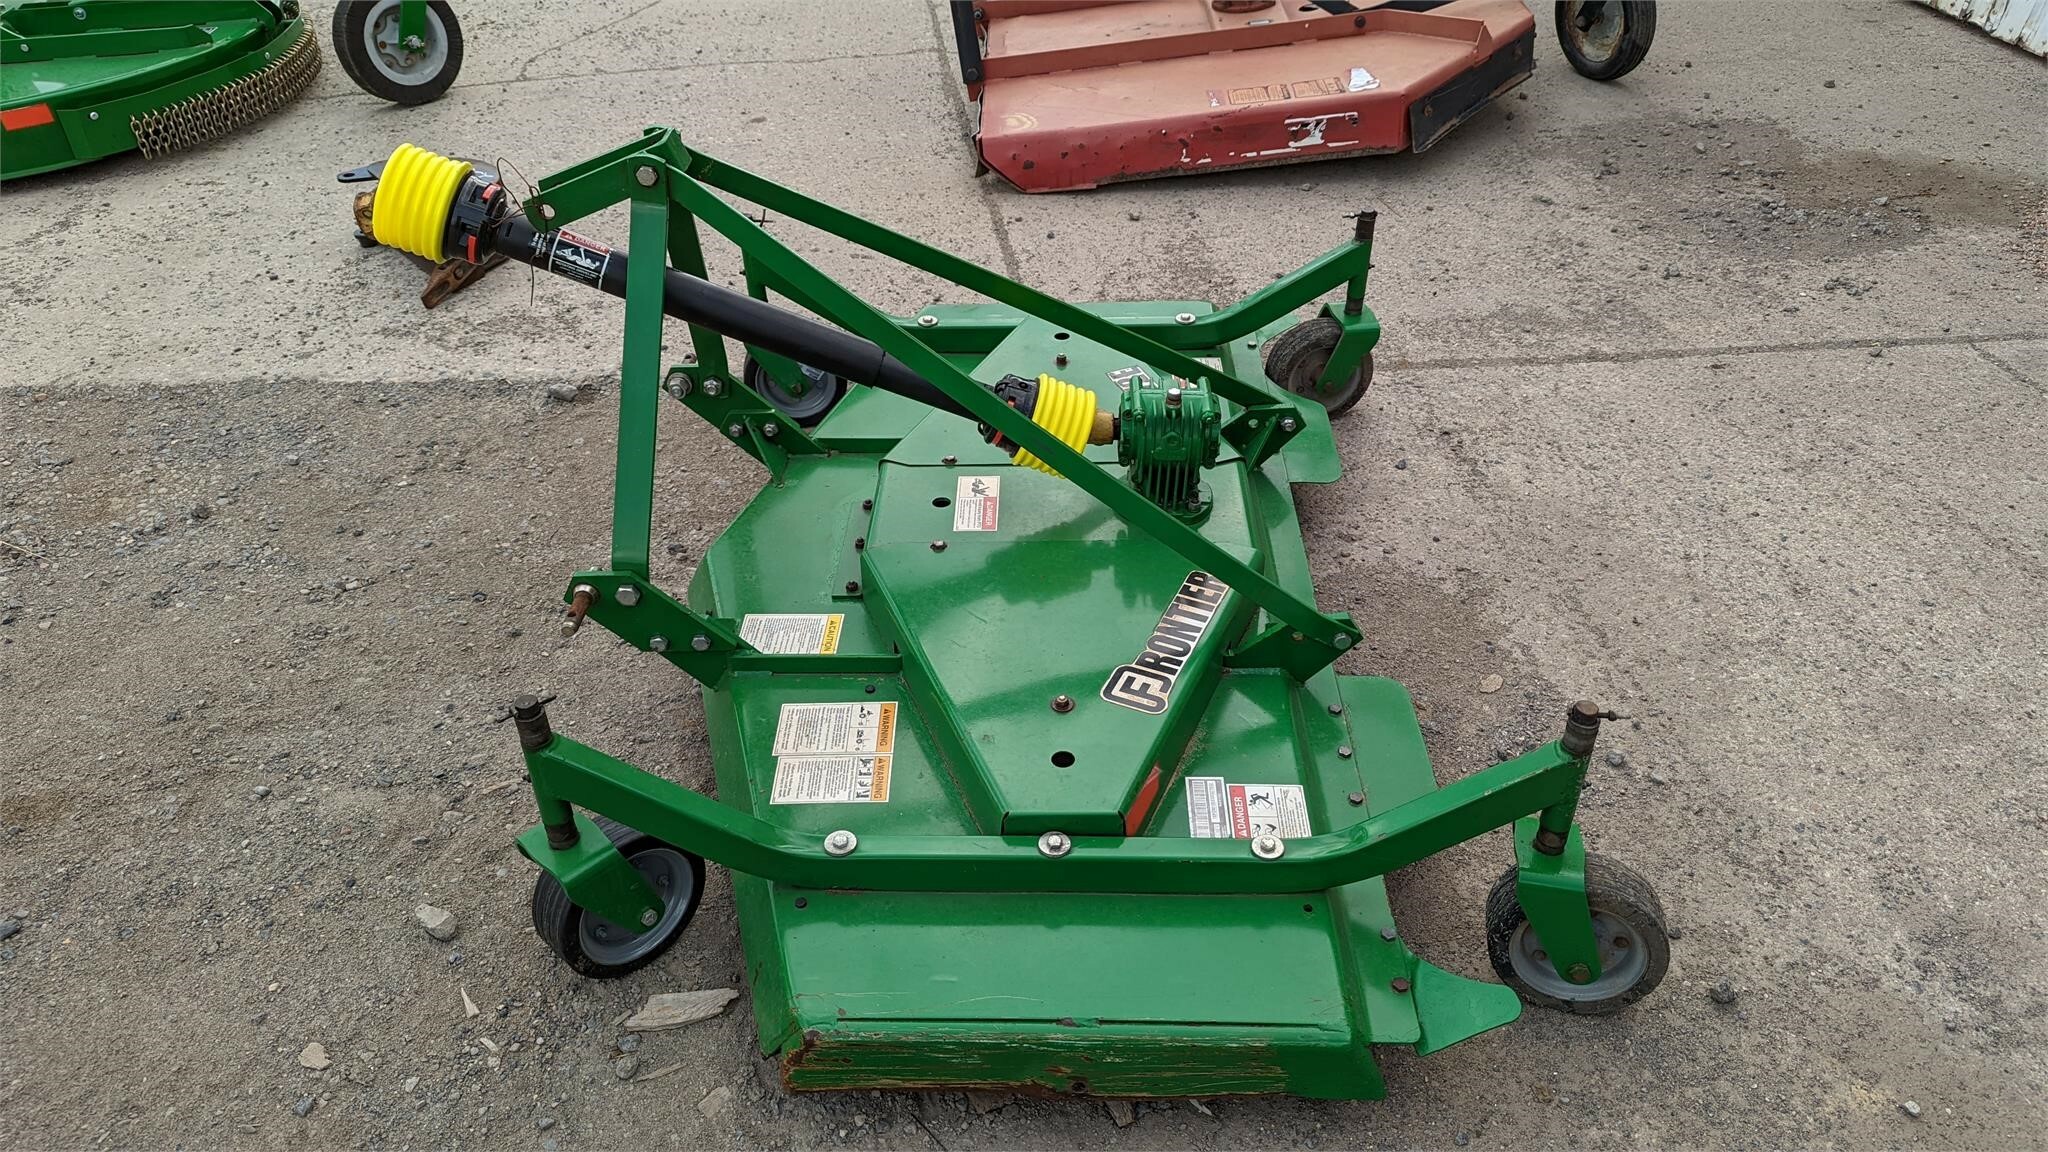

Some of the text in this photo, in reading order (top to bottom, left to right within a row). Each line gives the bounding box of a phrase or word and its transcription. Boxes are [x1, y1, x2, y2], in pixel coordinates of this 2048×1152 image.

[575, 236, 606, 252] DANGER
[825, 627, 836, 651] CAUTION
[1102, 571, 1228, 713] FRONTIER
[879, 714, 890, 747] WARNING
[874, 765, 885, 799] WARNING
[1234, 796, 1246, 832] DANGER
